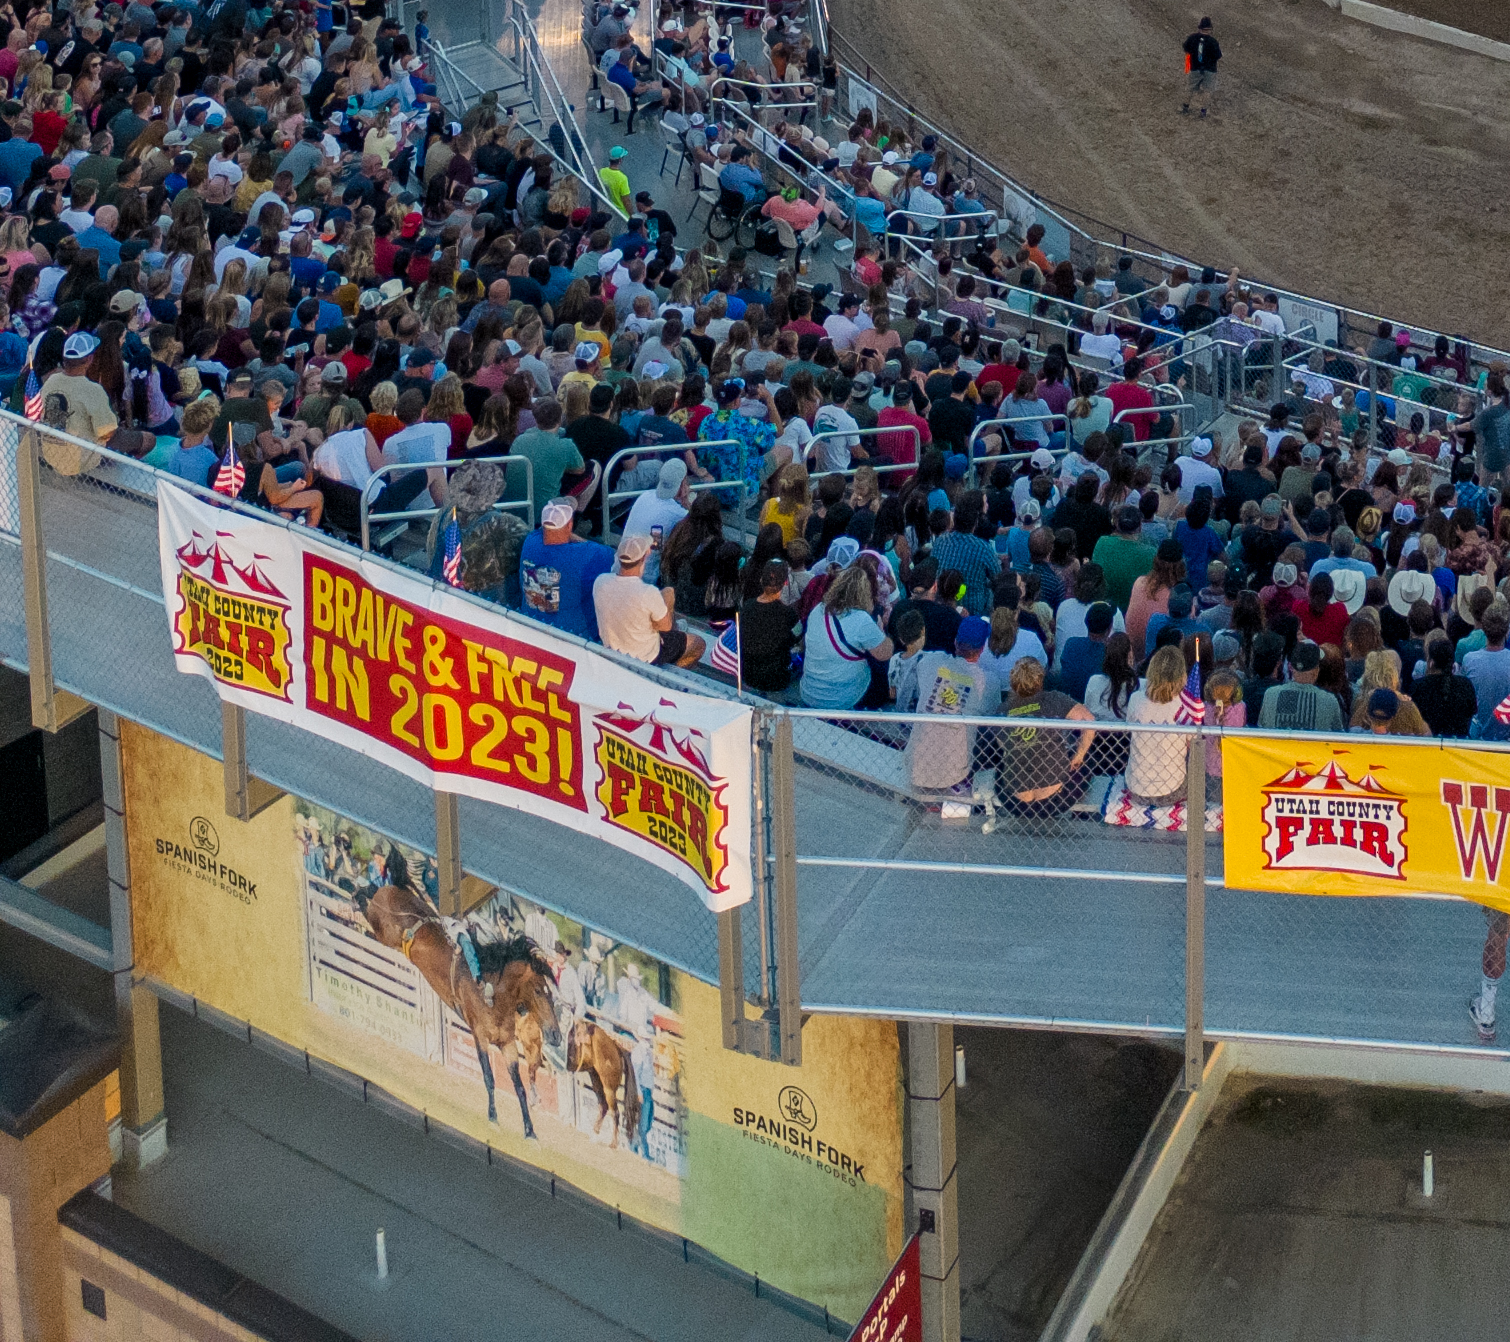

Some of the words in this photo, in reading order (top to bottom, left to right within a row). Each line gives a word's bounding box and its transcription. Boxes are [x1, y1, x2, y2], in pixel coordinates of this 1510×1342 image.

[1291, 303, 1324, 323] CIRCLE
[214, 594, 279, 630] COUNTY
[206, 647, 244, 682] 2023
[312, 566, 417, 675] BRAVE
[422, 624, 461, 690] &
[461, 638, 572, 724] FREE
[311, 635, 371, 723] IN
[388, 673, 576, 797] 2023!
[605, 736, 648, 777] UTAH
[652, 761, 711, 815] COUNTY
[608, 760, 713, 881] FAIR
[647, 814, 687, 857] 2023
[1274, 798, 1321, 816] UTAH
[1327, 800, 1395, 821] COUNTY
[156, 837, 217, 876] SPANISH
[220, 864, 258, 900] FORK
[1275, 815, 1395, 869] FAIR
[163, 856, 193, 875] FIESTA
[195, 869, 217, 887] DAYS
[220, 882, 251, 905] RODEO
[315, 965, 371, 1006] Timothy
[733, 1106, 814, 1154] SPANISH
[816, 1140, 866, 1182] FORK
[742, 1129, 780, 1153] FIESTA
[784, 1144, 813, 1167] DAYS
[815, 1159, 857, 1188] RODEO
